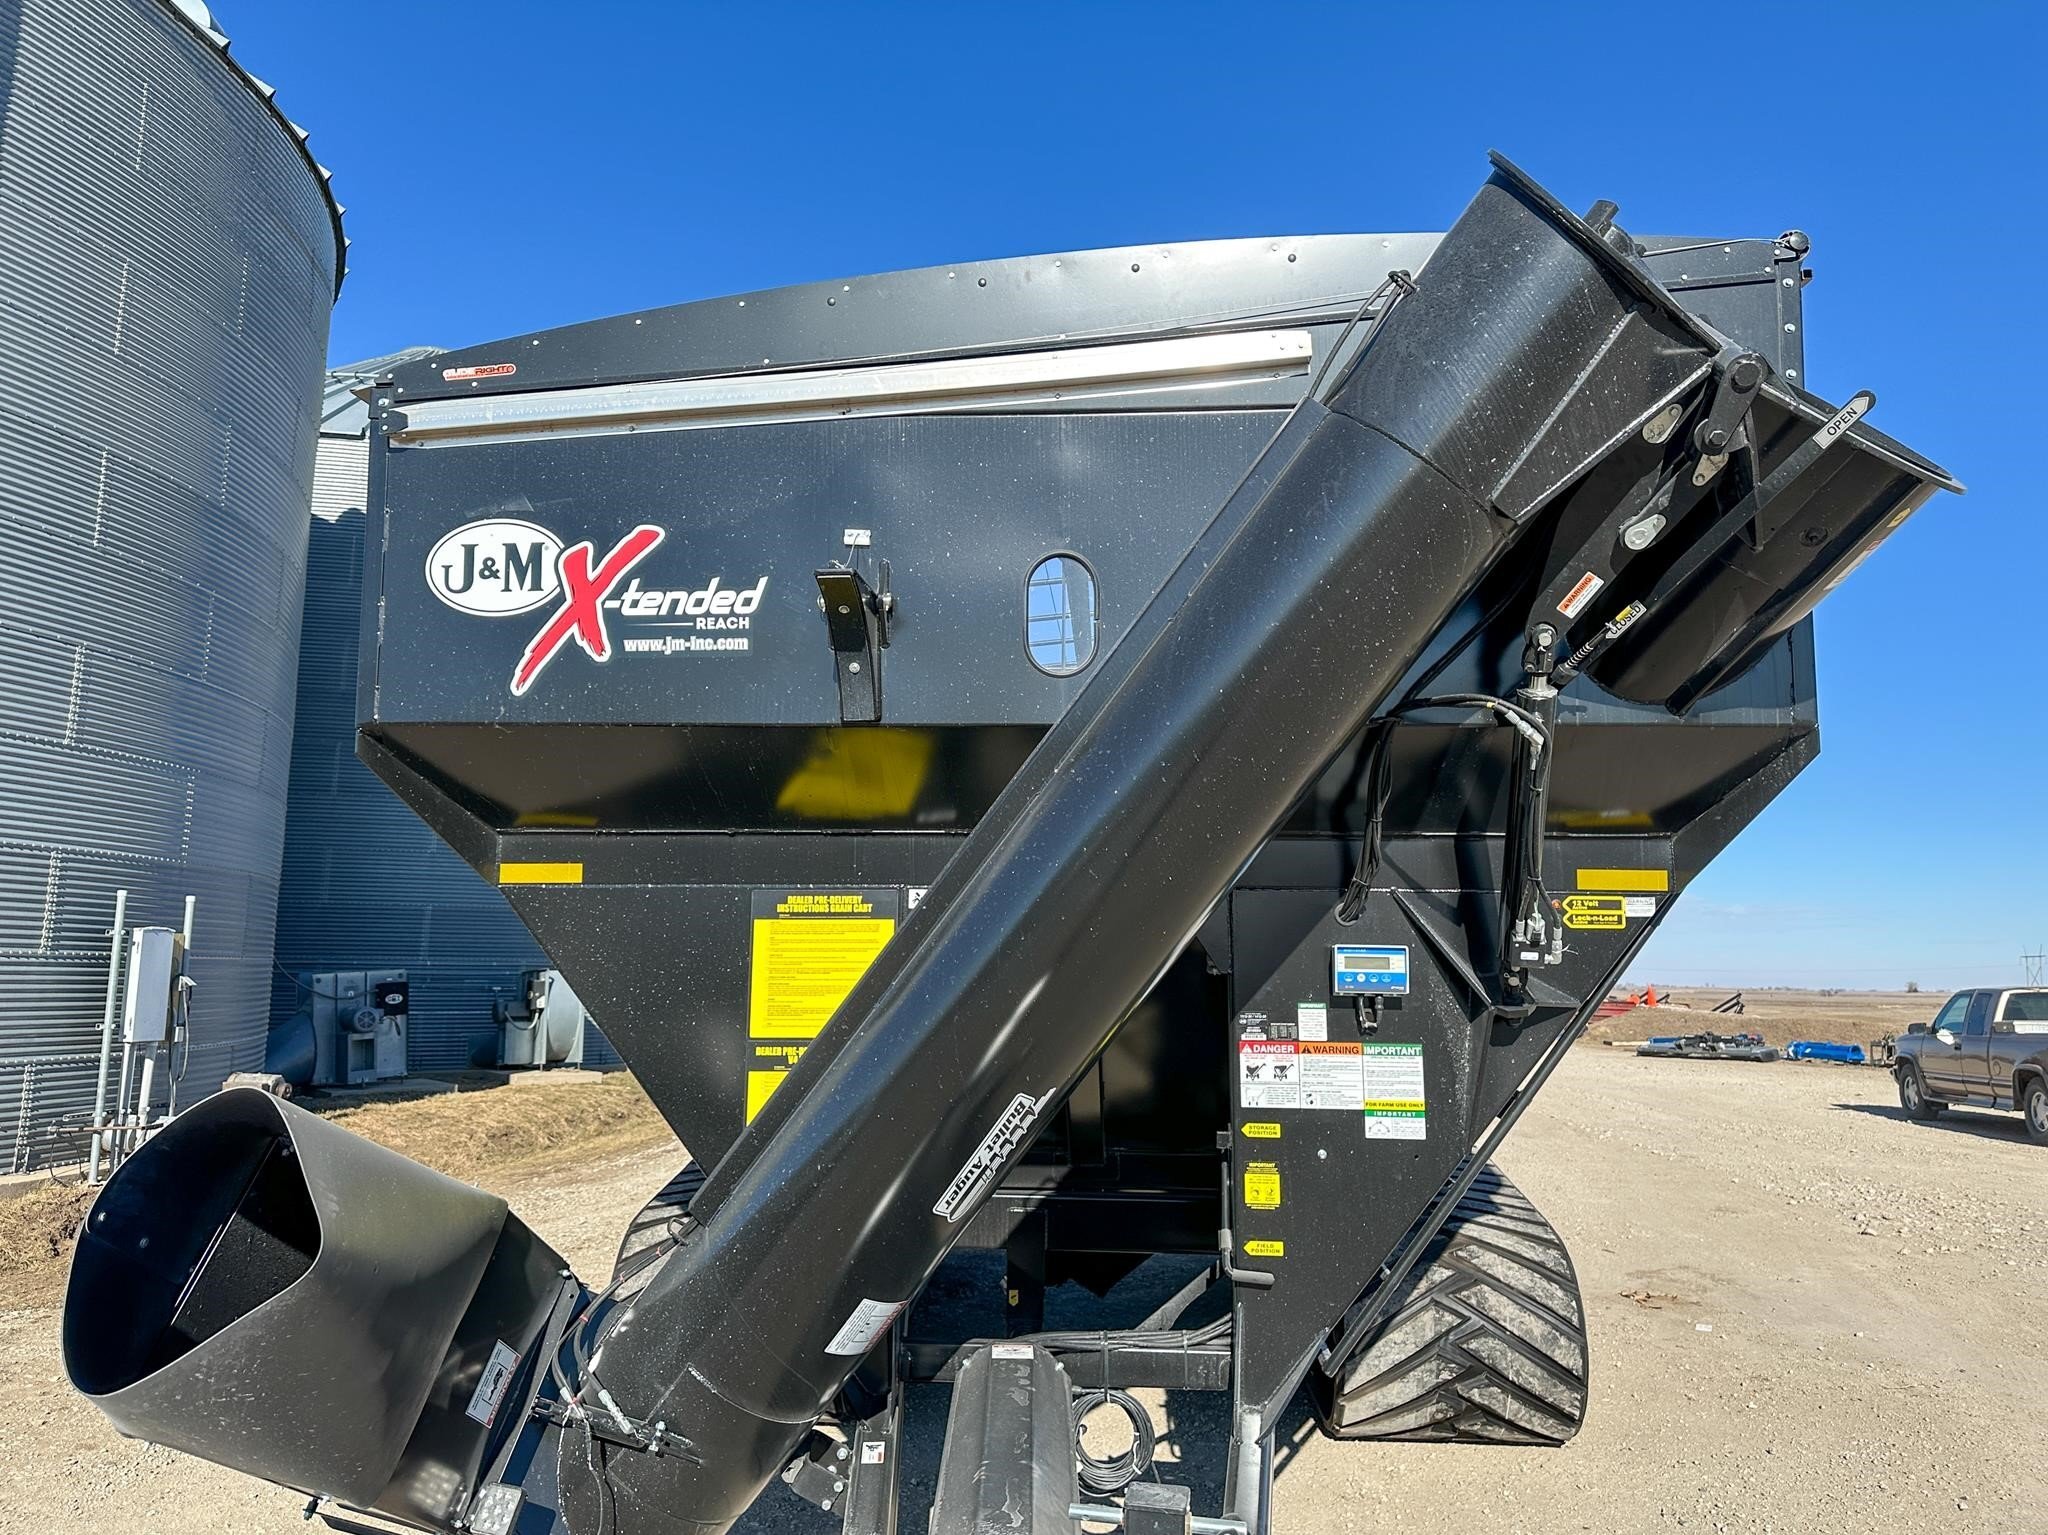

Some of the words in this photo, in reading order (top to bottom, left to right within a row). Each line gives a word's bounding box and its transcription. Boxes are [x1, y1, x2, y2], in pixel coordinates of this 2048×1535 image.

[1826, 407, 1858, 436] OPEN
[441, 542, 545, 594] J&M
[1567, 576, 1593, 604] WARNING
[696, 617, 750, 630] REACH
[1611, 604, 1642, 635] CLOSED
[623, 636, 749, 655] www.jm-inc.com
[787, 895, 814, 904] DEALER
[814, 895, 863, 904] PRE-DELIVERY
[776, 903, 830, 913] INSTRUCTIONS
[830, 903, 853, 913] GRAIN
[853, 904, 873, 912] CART
[755, 1046, 783, 1056] DEALER
[1252, 1044, 1295, 1054] DANGER
[1312, 1045, 1360, 1055] WARNING
[1364, 1046, 1422, 1056] IMPORTANT
[983, 1100, 1027, 1155] Bullet
[945, 1155, 984, 1210] Auger
